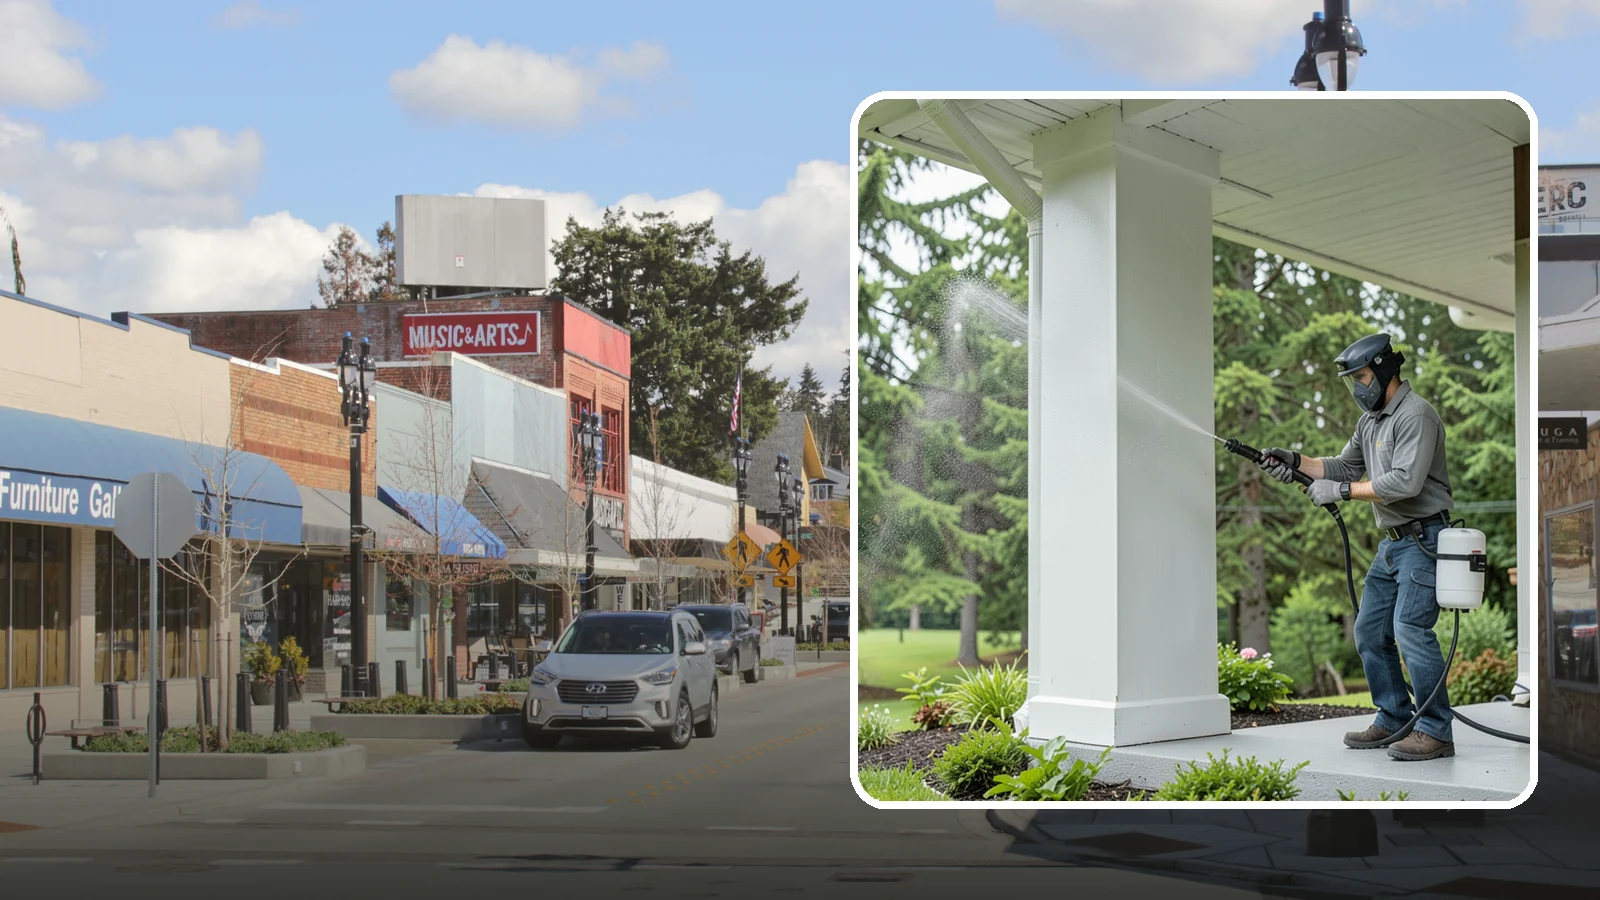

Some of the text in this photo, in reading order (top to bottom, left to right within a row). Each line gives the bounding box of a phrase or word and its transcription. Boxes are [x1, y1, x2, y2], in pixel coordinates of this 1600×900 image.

[1540, 427, 1577, 437] UGA
[0, 471, 121, 519] Furniture Gal
[453, 563, 479, 574] SUSHI
